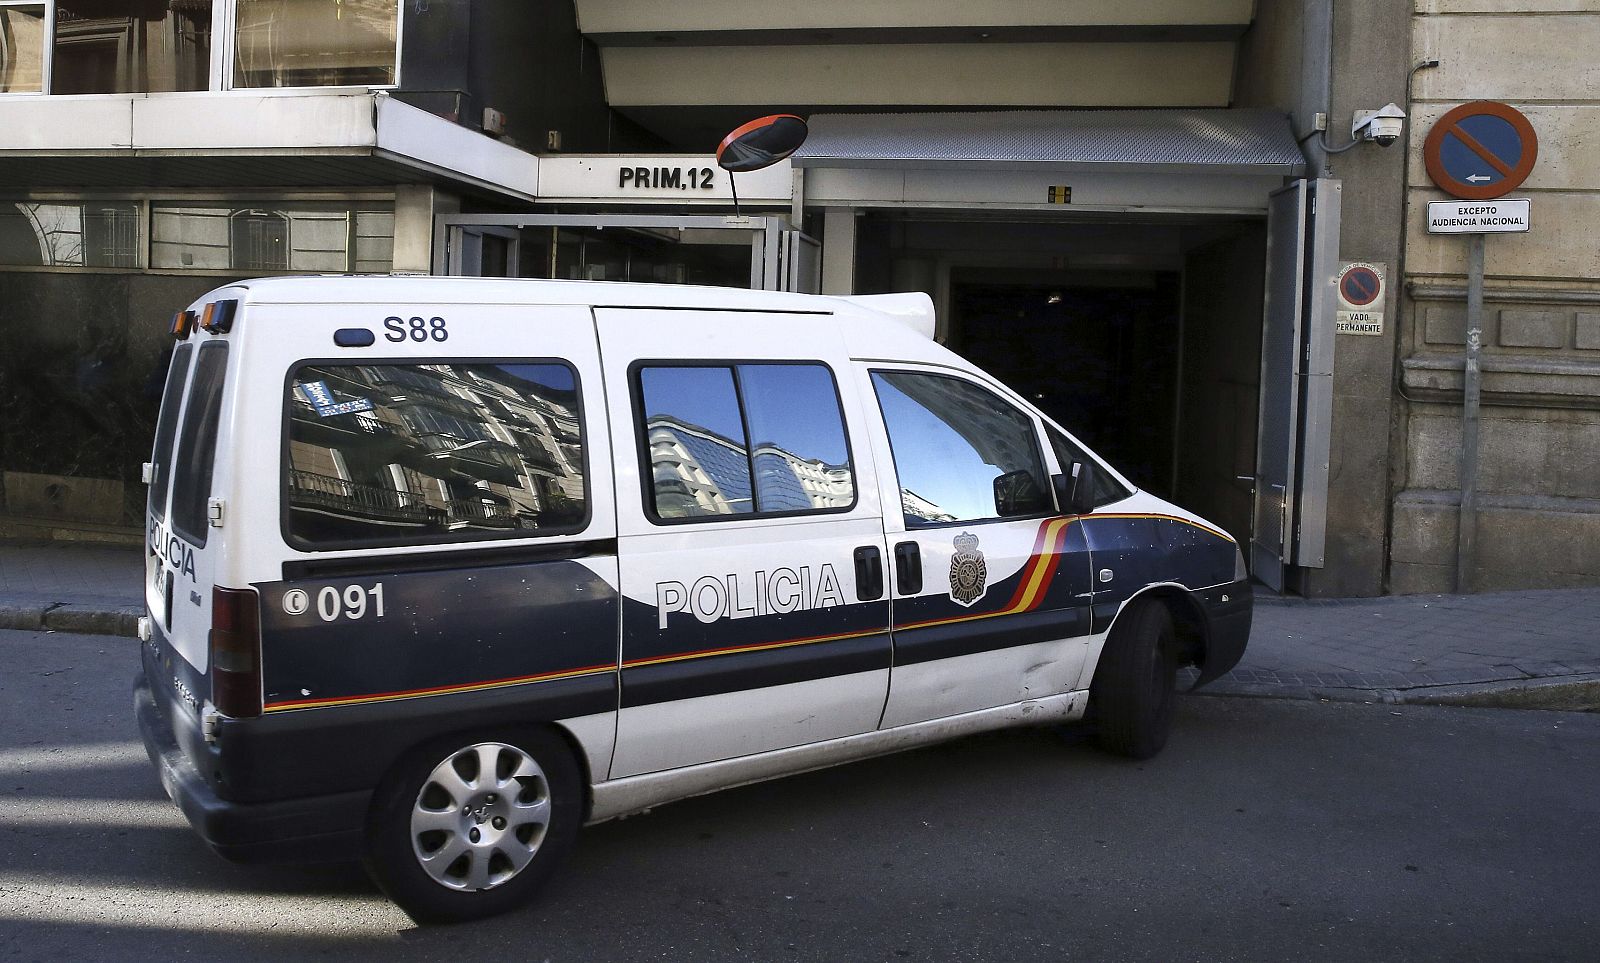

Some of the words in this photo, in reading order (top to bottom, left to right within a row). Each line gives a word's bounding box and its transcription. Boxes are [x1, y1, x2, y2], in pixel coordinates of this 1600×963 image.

[619, 167, 714, 190] PRIM,12
[1432, 218, 1477, 227] AUDIENCIA
[1480, 217, 1524, 226] NACIONAL
[1458, 207, 1497, 215] EXCEPTO
[1336, 323, 1380, 333] PERMANENTE
[1349, 313, 1369, 321] VADO
[384, 316, 449, 342] S88
[150, 516, 196, 583] POLICIA
[317, 582, 384, 622] 091
[655, 563, 846, 630] POLICIA
